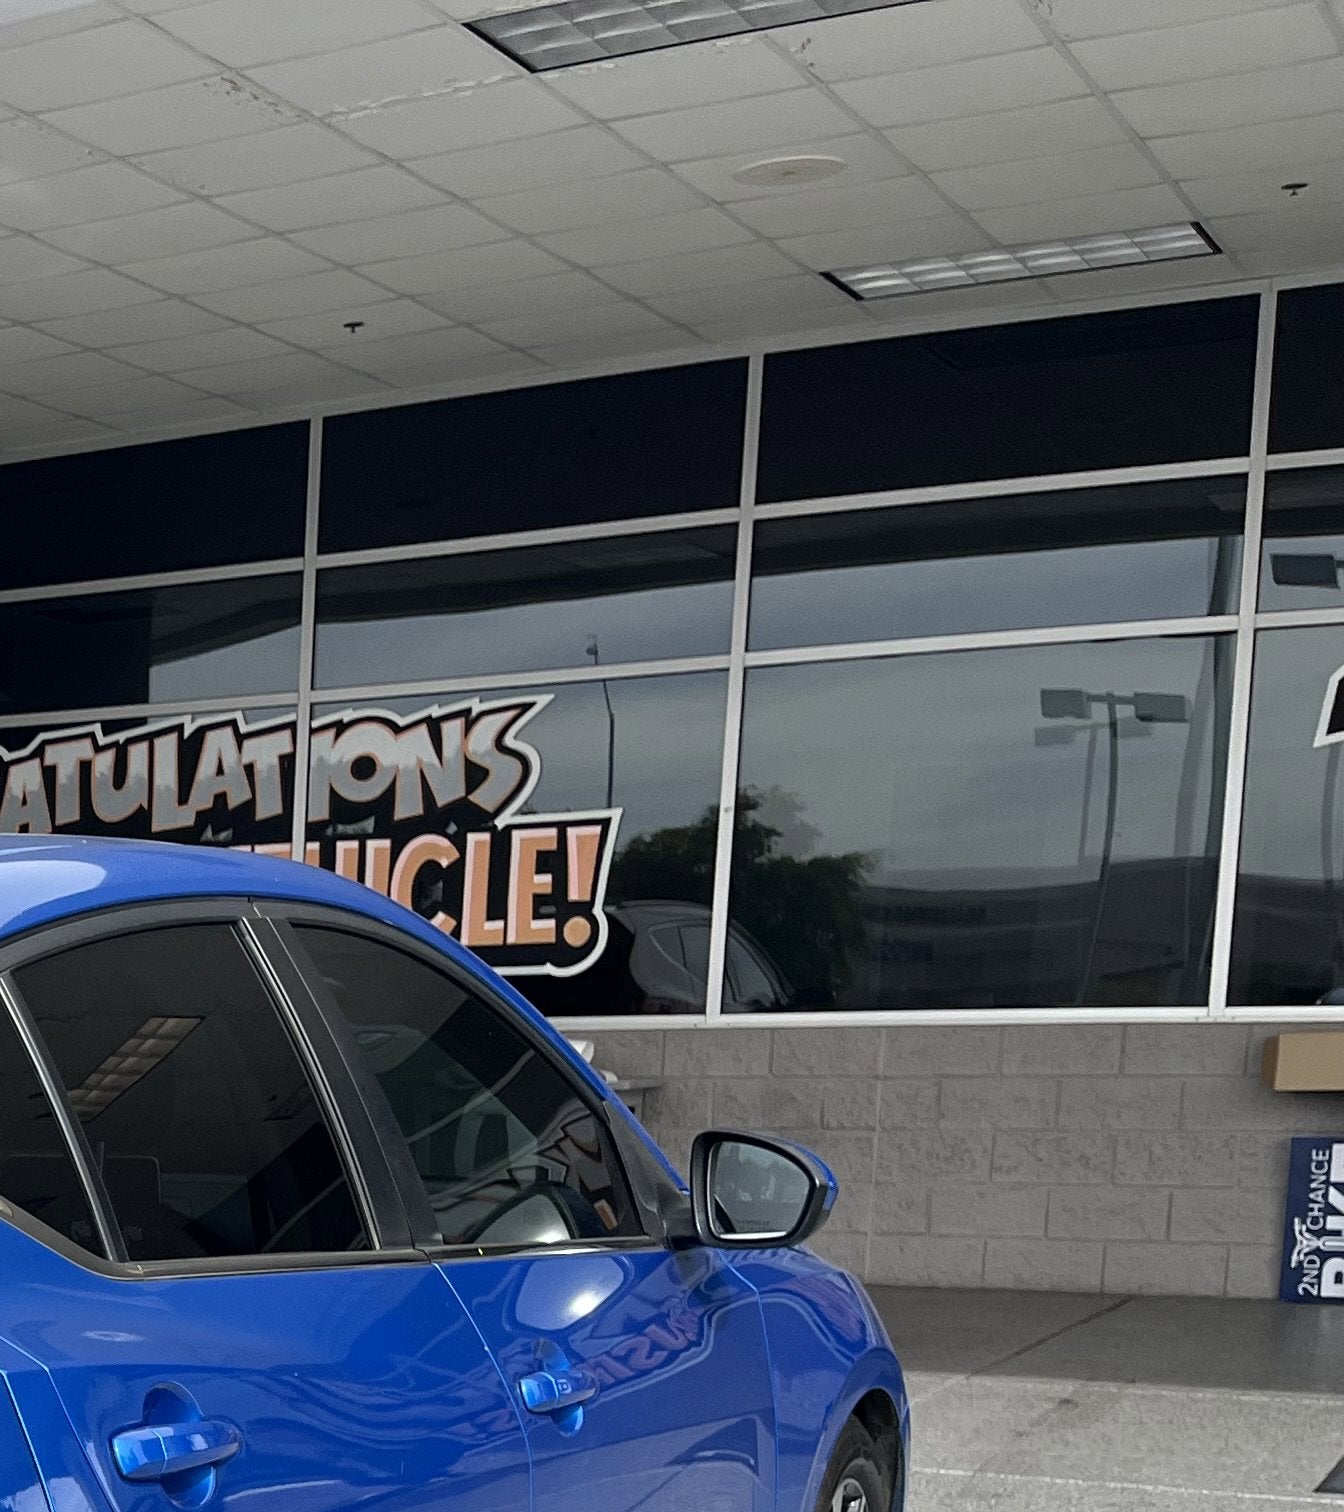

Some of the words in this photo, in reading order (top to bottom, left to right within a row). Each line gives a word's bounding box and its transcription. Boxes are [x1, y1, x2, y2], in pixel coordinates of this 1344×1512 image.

[228, 825, 603, 948] ICLE!
[1306, 1148, 1329, 1231] CHANCE
[1297, 1254, 1321, 1297] 2ND
